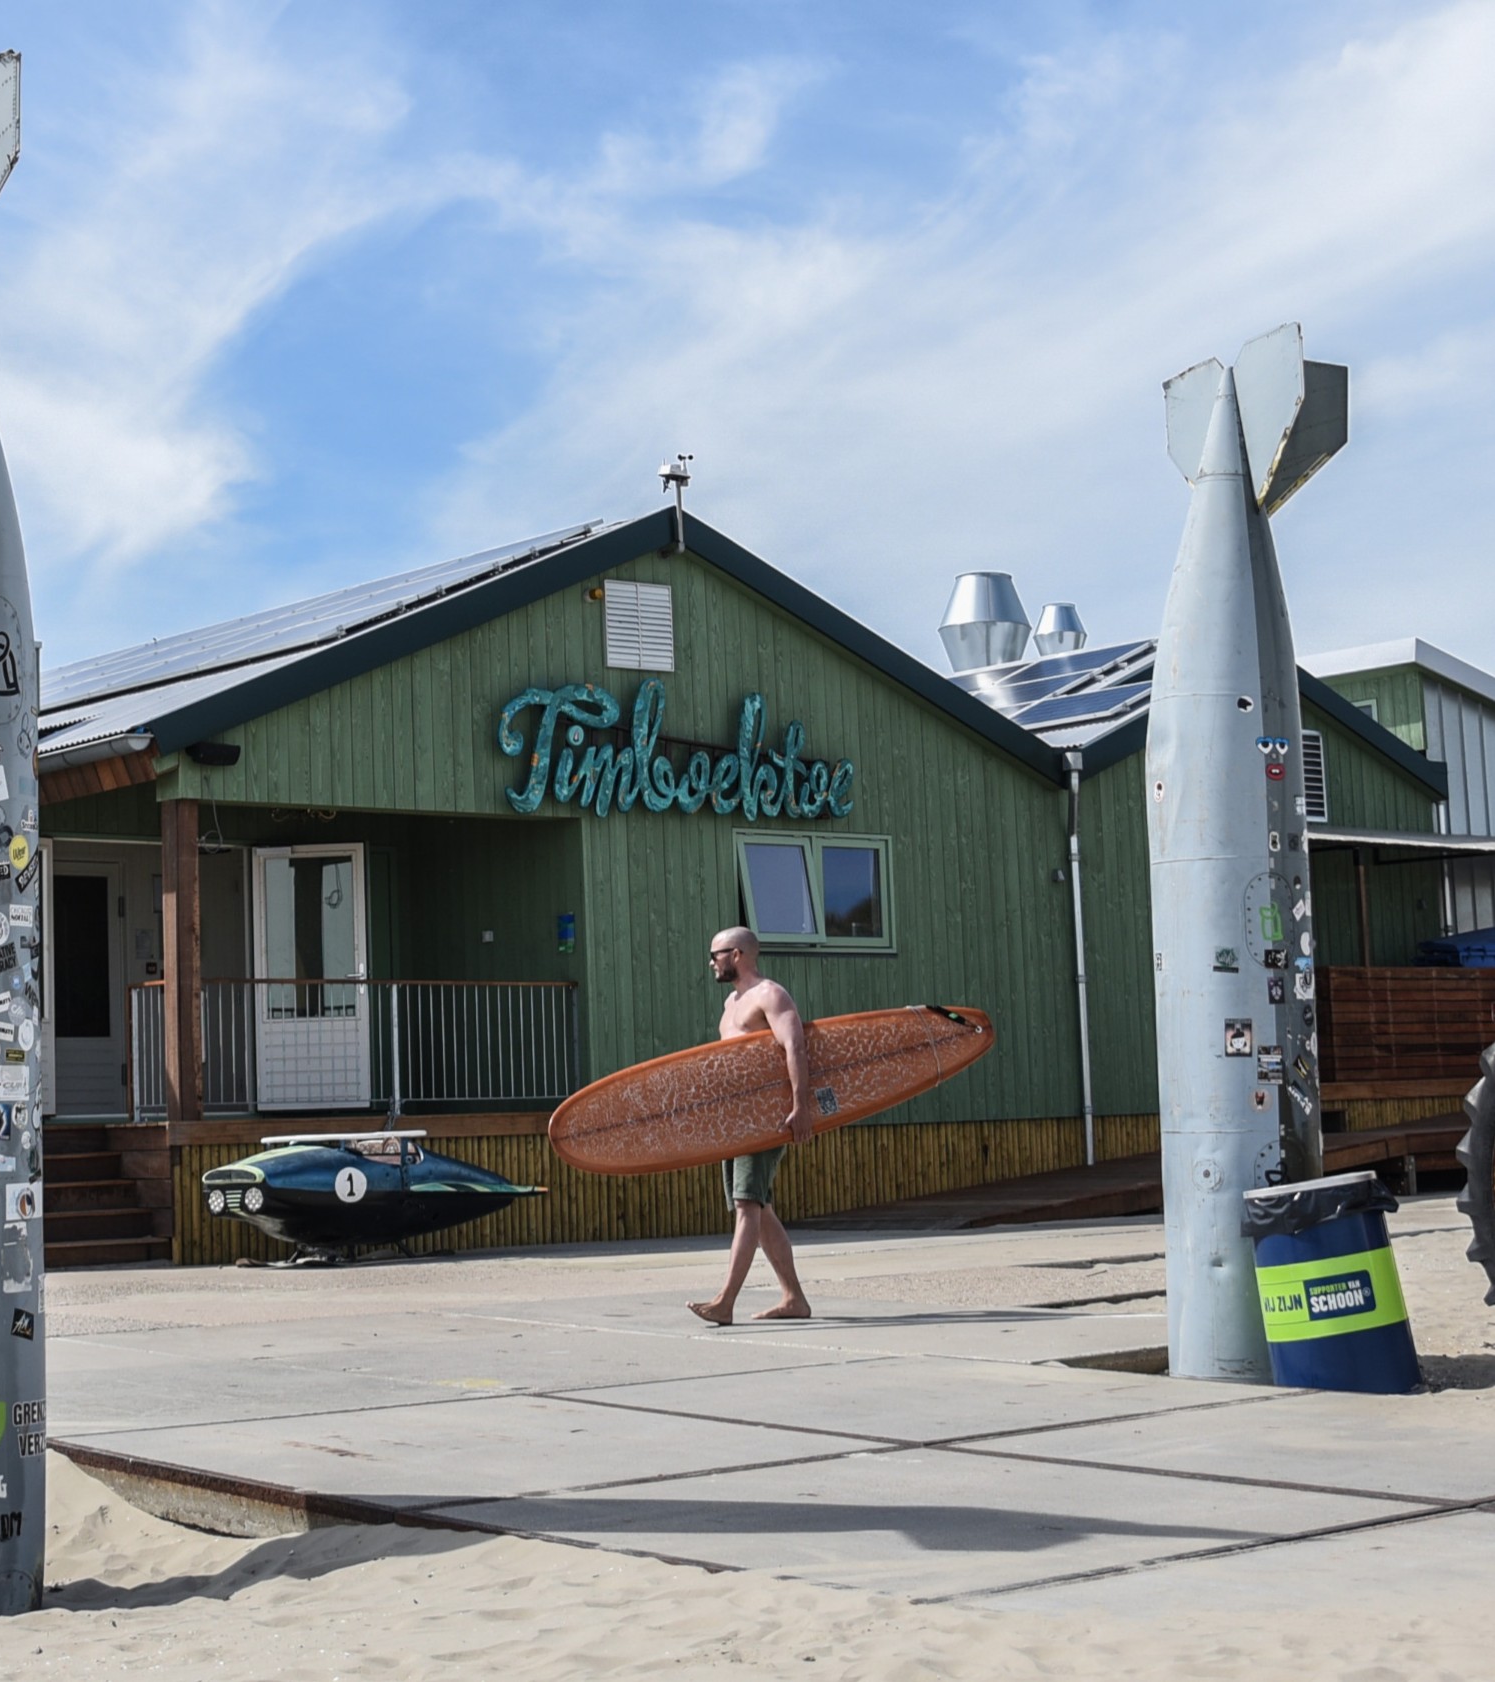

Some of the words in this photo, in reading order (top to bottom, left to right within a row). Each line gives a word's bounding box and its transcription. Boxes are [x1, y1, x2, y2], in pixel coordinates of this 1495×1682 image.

[345, 1172, 357, 1197] 1
[1309, 1282, 1347, 1296] SUPPORTER
[1347, 1279, 1361, 1290] VAN
[1276, 1293, 1303, 1312] ZIJN
[1310, 1289, 1364, 1313] SCHOON
